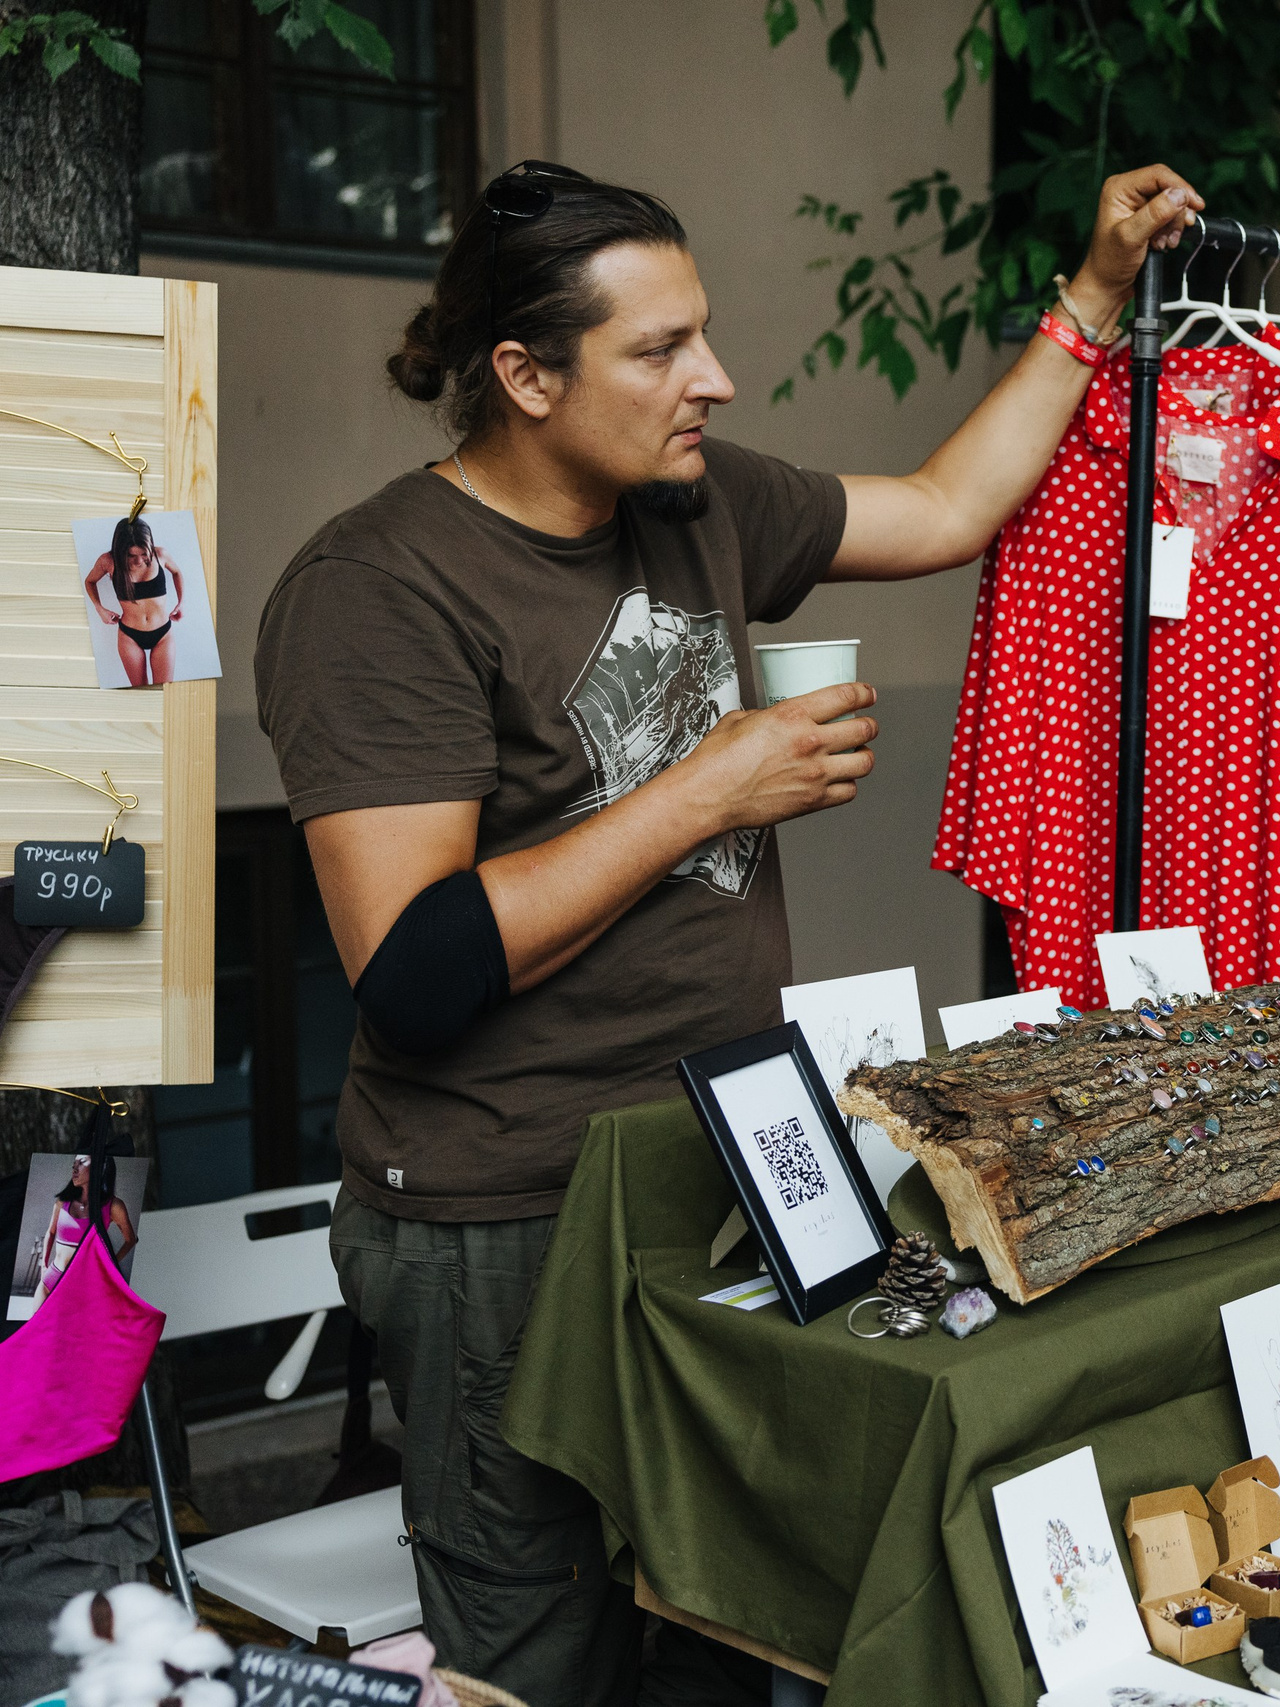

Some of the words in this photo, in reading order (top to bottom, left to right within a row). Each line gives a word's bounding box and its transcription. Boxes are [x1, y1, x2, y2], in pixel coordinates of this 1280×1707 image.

[566, 710, 584, 736] HUNTERS
[580, 736, 588, 745] BY
[584, 744, 597, 770] CREATED
